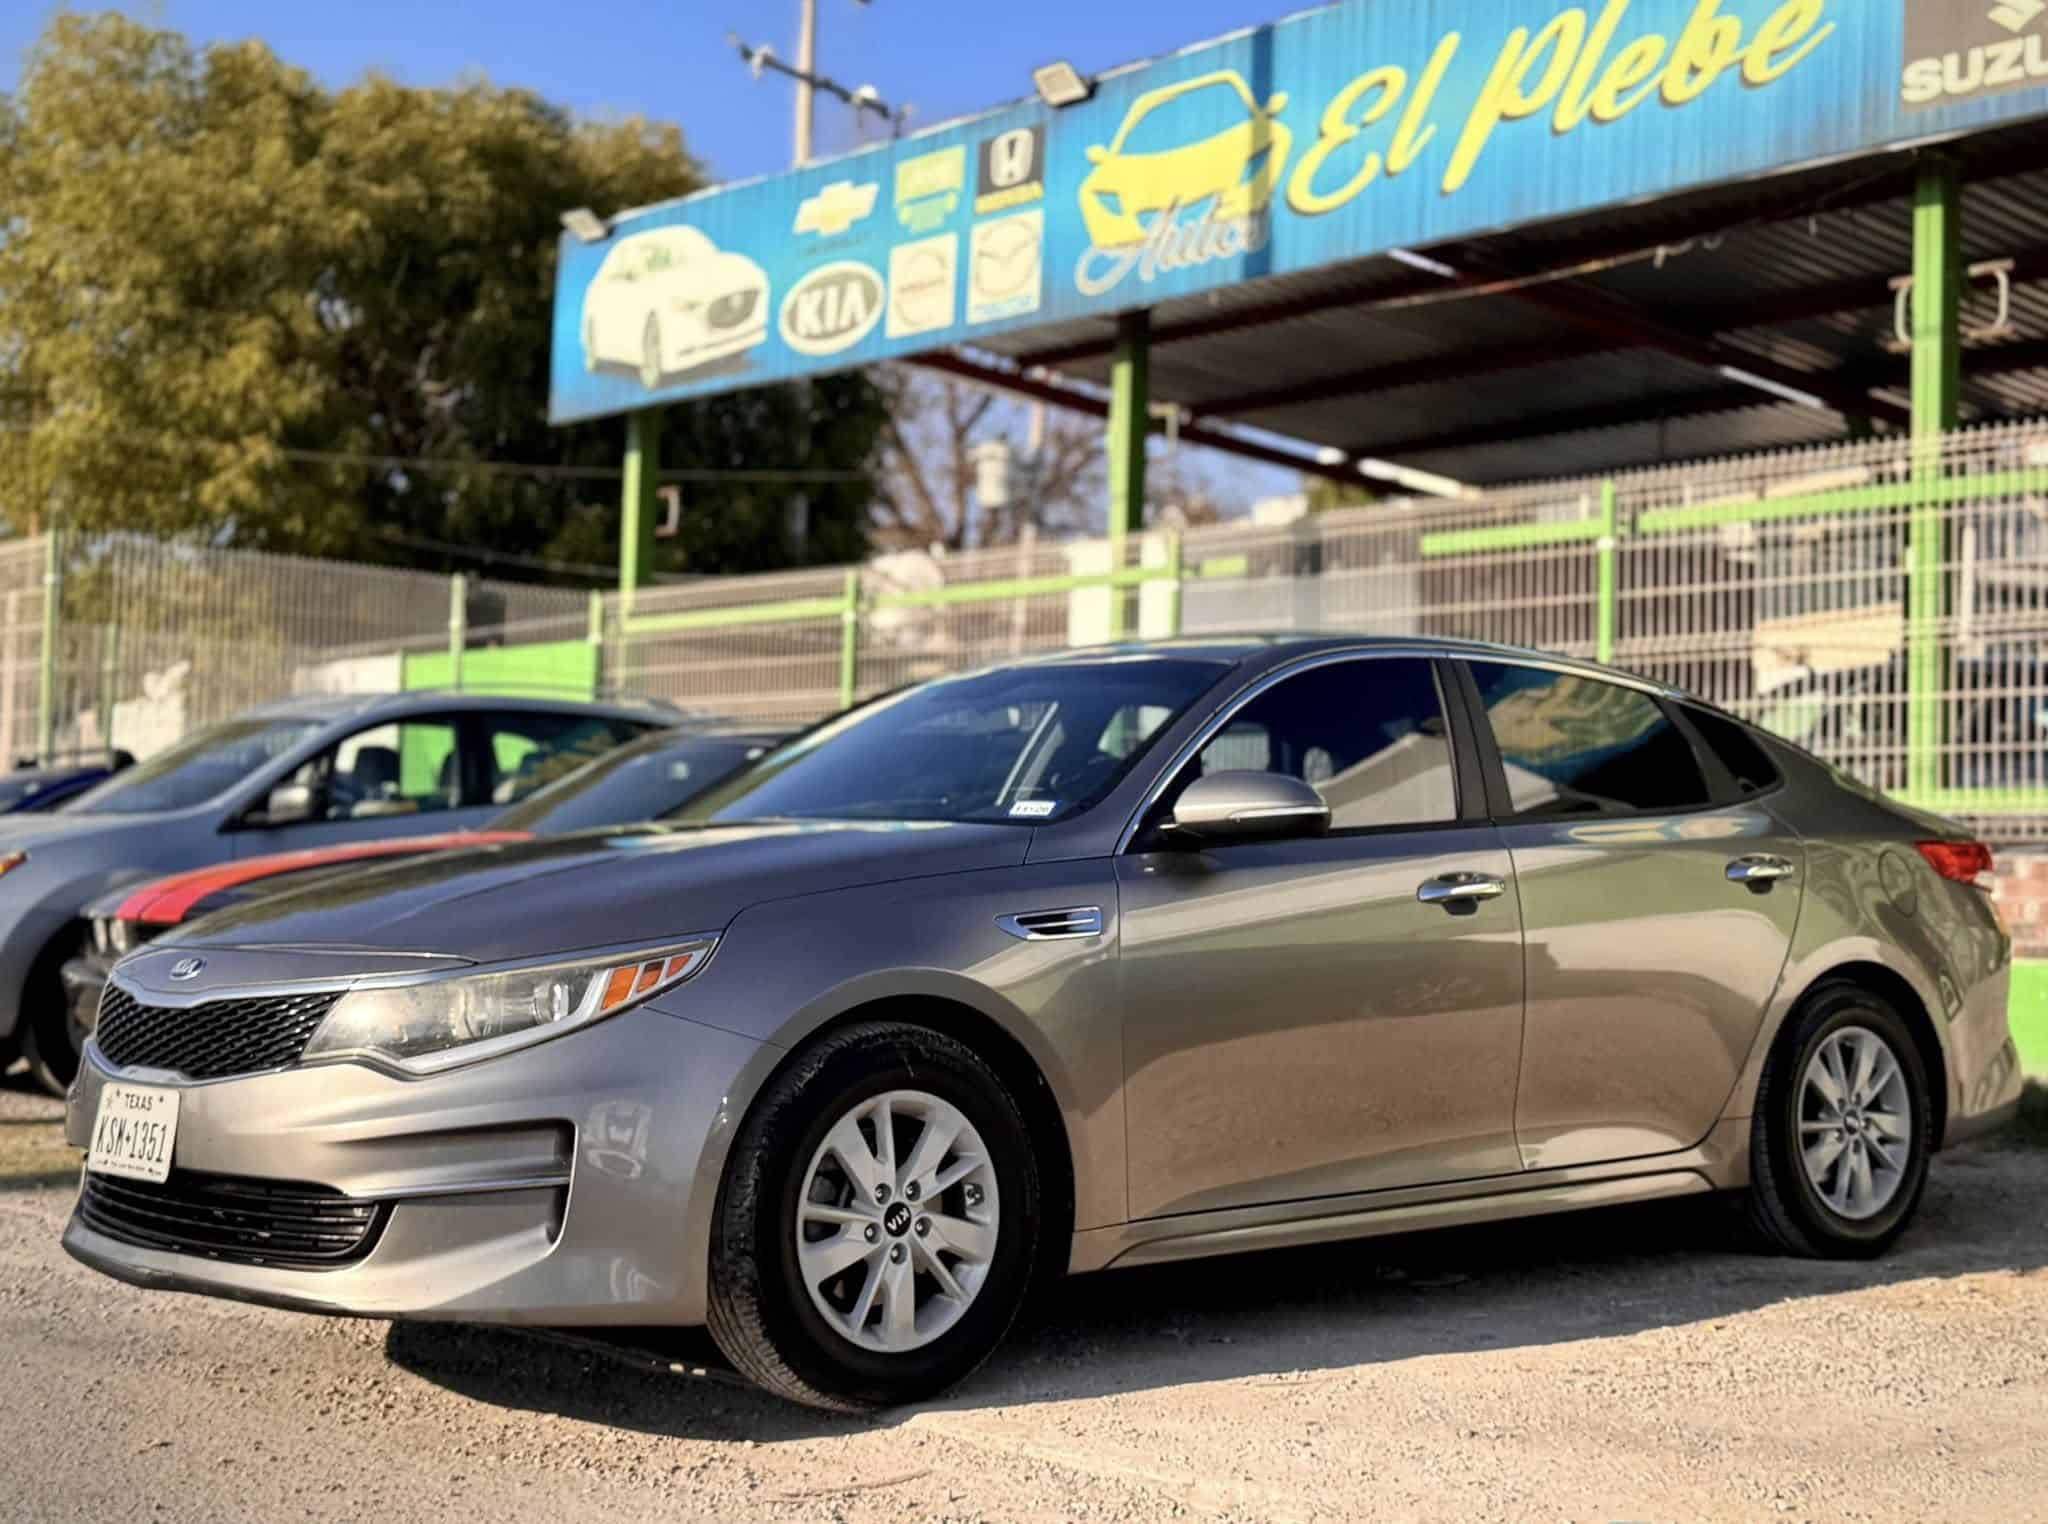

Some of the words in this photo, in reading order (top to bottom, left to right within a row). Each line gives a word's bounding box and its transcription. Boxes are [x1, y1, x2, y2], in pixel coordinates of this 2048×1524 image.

[1286, 31, 1460, 214] El
[793, 280, 870, 336] KIA
[125, 1093, 153, 1111] TEXAS
[887, 1207, 910, 1231] KIA
